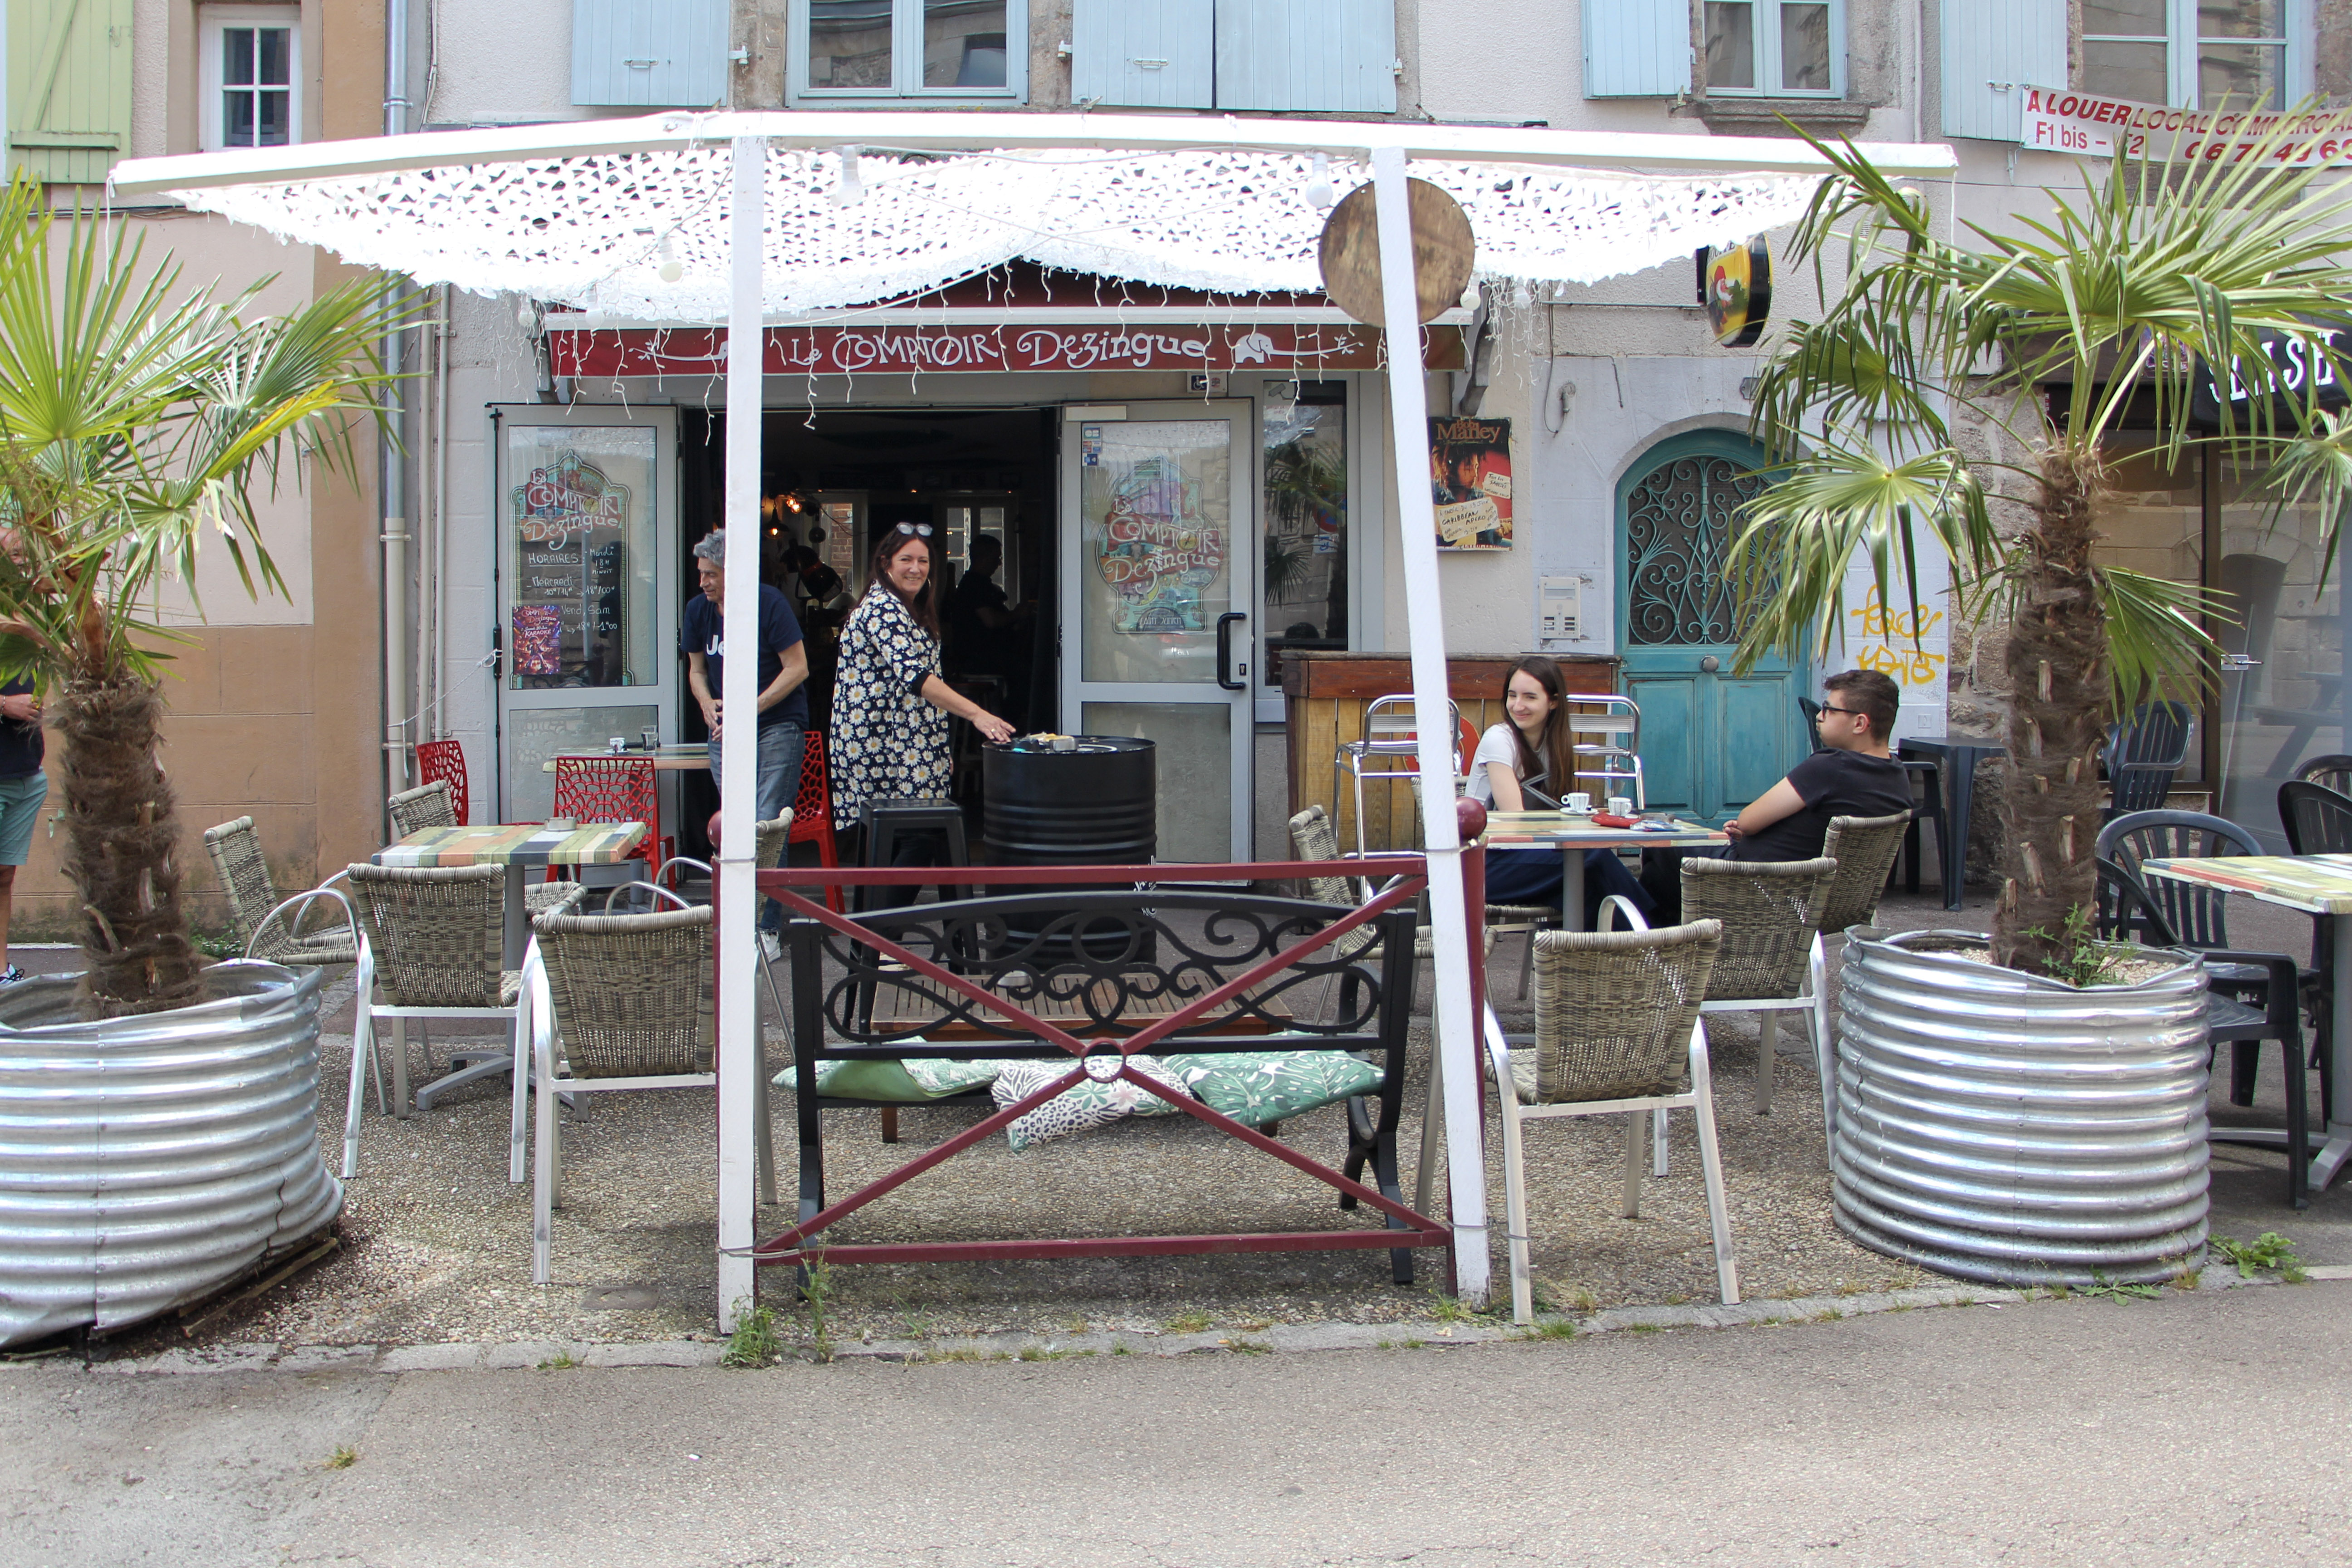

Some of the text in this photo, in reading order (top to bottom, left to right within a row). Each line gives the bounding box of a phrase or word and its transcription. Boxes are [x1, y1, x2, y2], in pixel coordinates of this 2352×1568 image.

[2026, 90, 2041, 113] A
[2046, 93, 2133, 126] LOUER
[2036, 121, 2054, 146] F1
[2061, 124, 2087, 149] bis
[2127, 133, 2144, 154] 2
[2184, 141, 2226, 160] 06
[789, 338, 823, 366] Le
[1016, 330, 1205, 369] Dezingue
[1436, 421, 1501, 444] Marley
[531, 470, 547, 485] Le
[523, 515, 618, 551] Dezingue
[1442, 510, 1478, 525] CARIBBEAN
[1103, 552, 1220, 595] Dezingue
